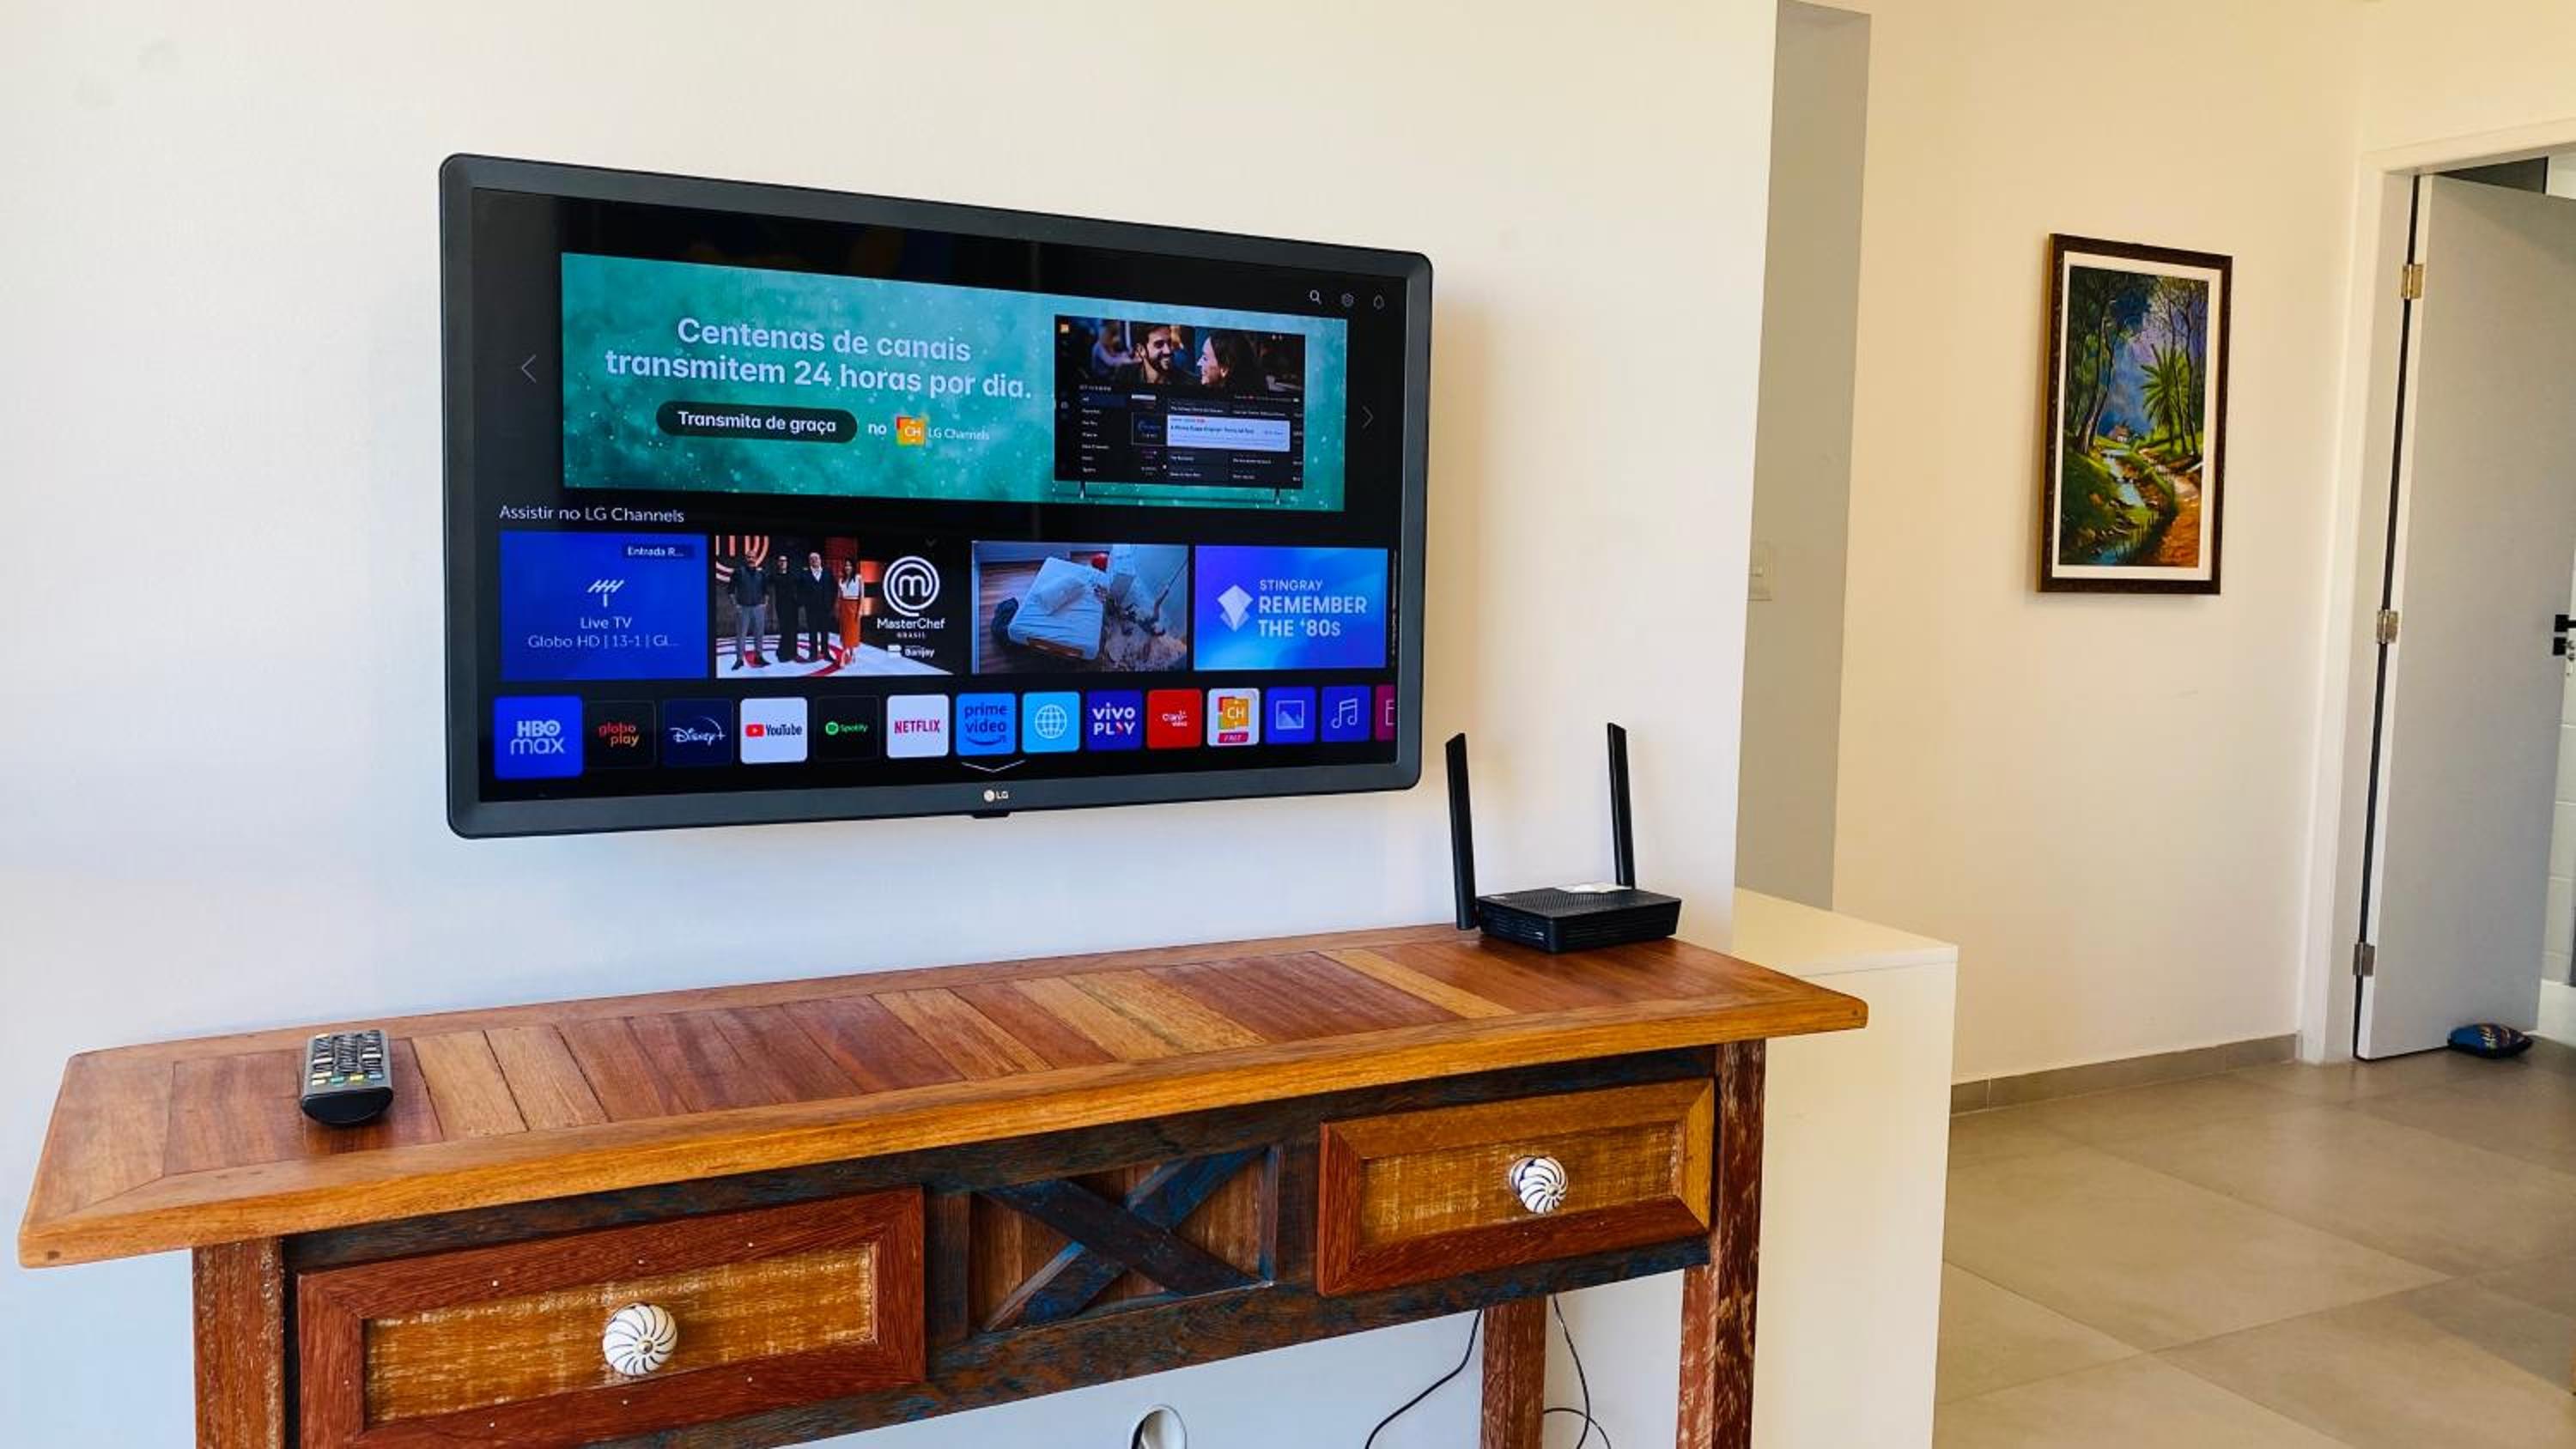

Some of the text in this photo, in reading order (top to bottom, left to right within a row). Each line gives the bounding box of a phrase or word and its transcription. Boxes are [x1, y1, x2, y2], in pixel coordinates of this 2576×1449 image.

[677, 316, 971, 362] Centenas de canais
[605, 349, 1032, 399] transmitem 24 horas por dia.
[677, 410, 837, 435] Transmita de graça
[867, 421, 888, 436] no
[903, 427, 922, 438] CH
[927, 427, 990, 442] LG Channels
[499, 505, 685, 524] Assistir no LG Channels
[627, 545, 665, 557] Entrada
[1259, 579, 1323, 591] STINGRAY
[1258, 596, 1368, 615] REMEMBER
[580, 616, 633, 630] Live TV
[877, 617, 945, 629] MasterChef
[1258, 619, 1297, 639] THE
[527, 634, 574, 649] Globo
[576, 635, 600, 648] HD
[612, 634, 641, 647] 13-1
[964, 702, 1008, 718] prime
[1092, 702, 1135, 719] vivo
[1226, 706, 1245, 718] CH
[516, 719, 562, 737] HBO
[598, 722, 636, 737] globo
[669, 716, 726, 746] Disney+
[765, 724, 803, 737] YouTube
[839, 724, 868, 734] Spotify
[894, 719, 940, 734] NETFLIX
[965, 719, 1006, 732] video
[510, 737, 565, 755] max
[610, 734, 640, 748] play
[995, 791, 1009, 799] LG
